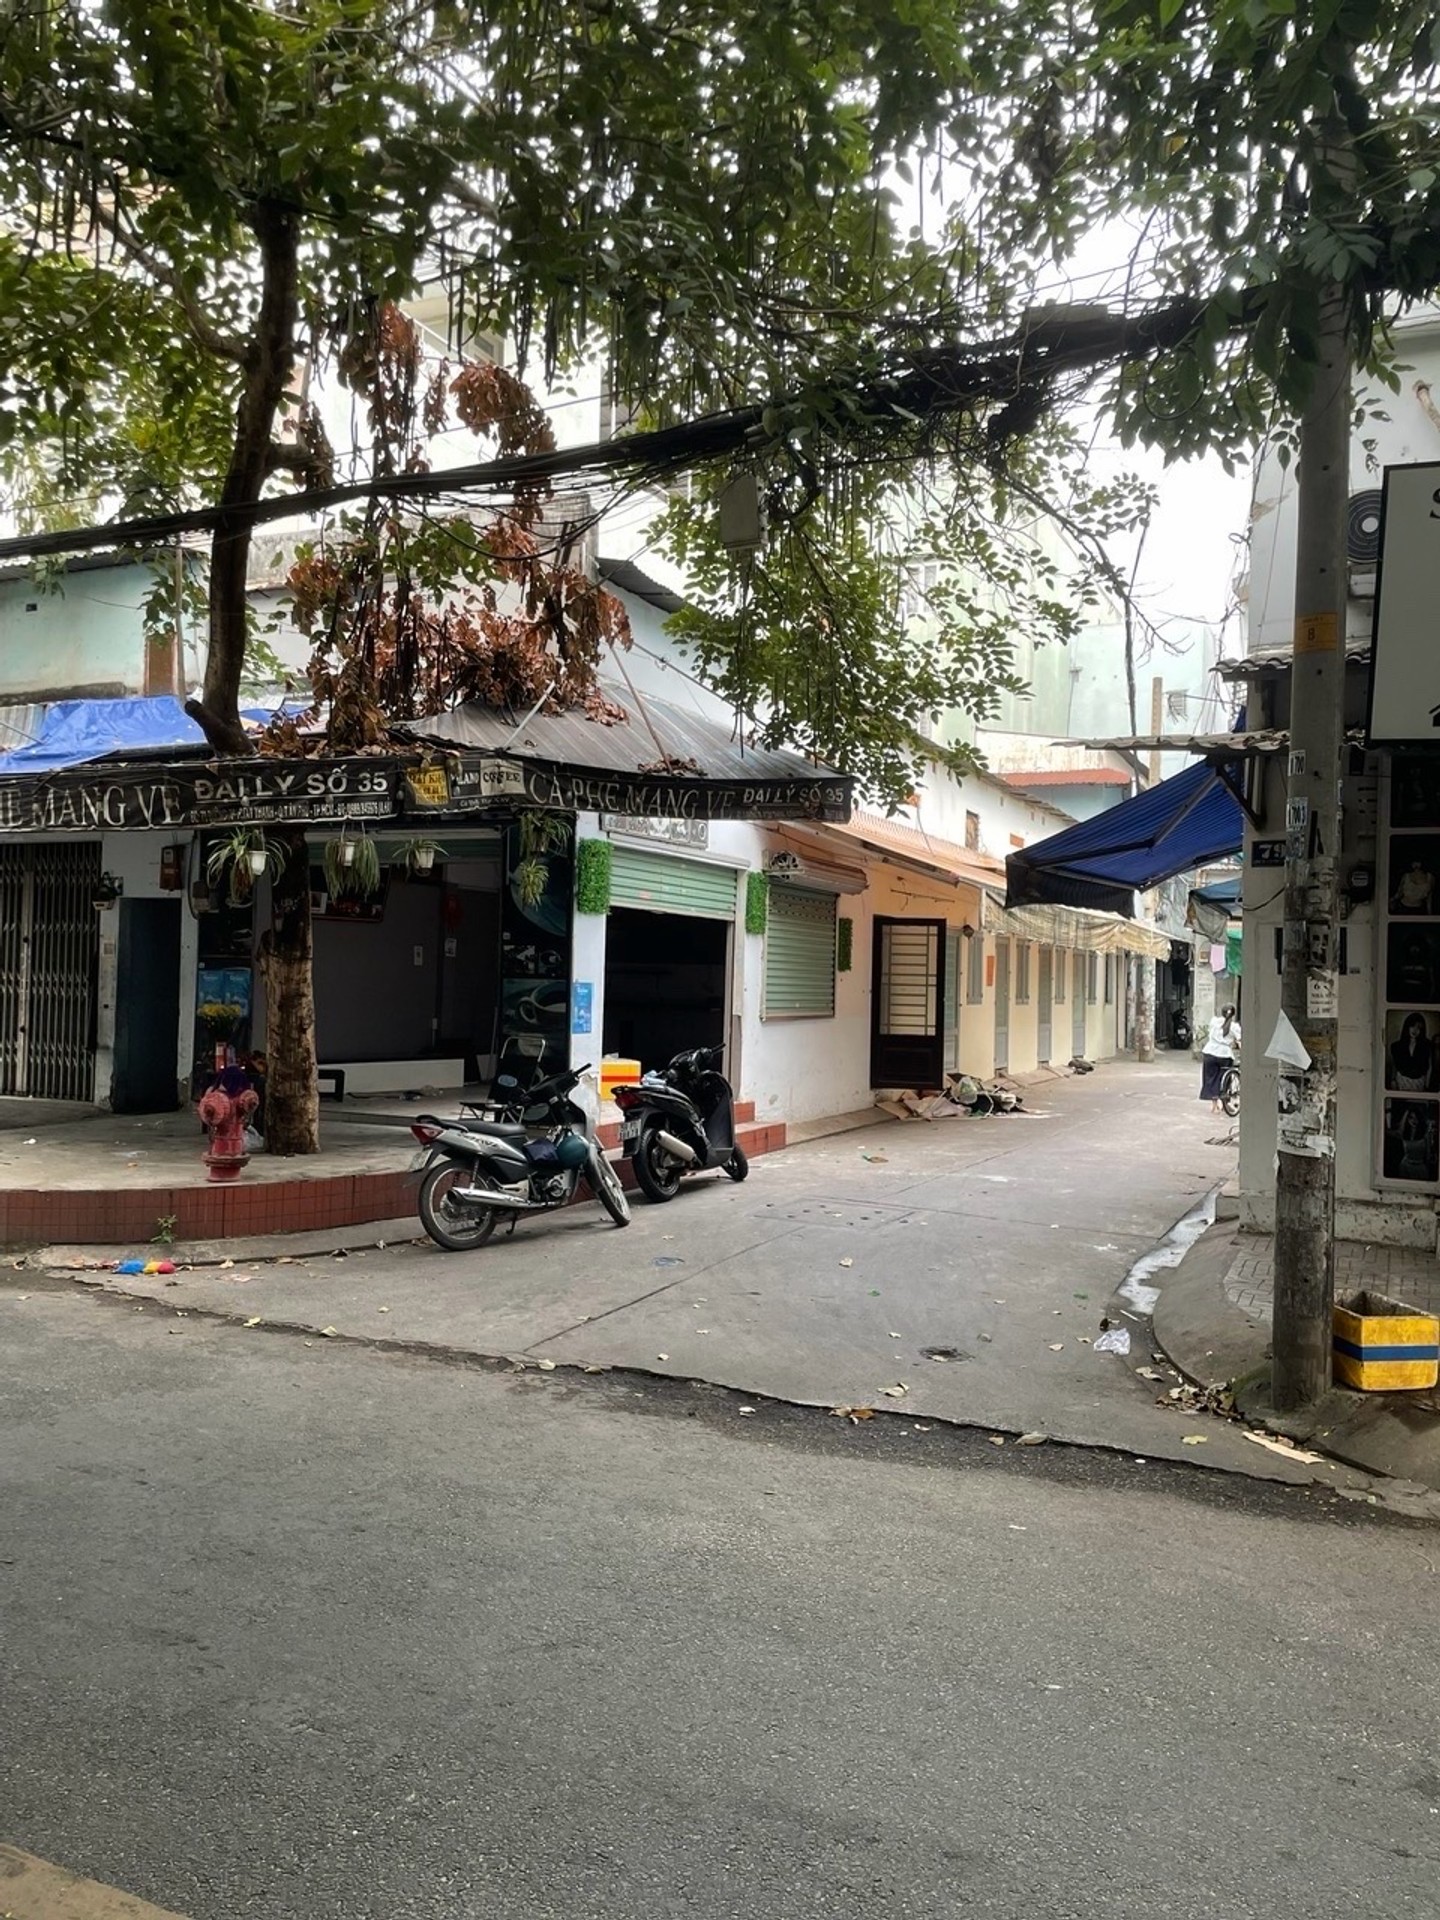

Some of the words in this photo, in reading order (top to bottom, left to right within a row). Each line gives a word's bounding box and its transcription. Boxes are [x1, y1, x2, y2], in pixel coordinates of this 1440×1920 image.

[307, 765, 348, 794] SỐ
[358, 772, 388, 792] 35
[825, 787, 844, 803] 35
[31, 784, 127, 826] MANG
[625, 784, 699, 819] MANG
